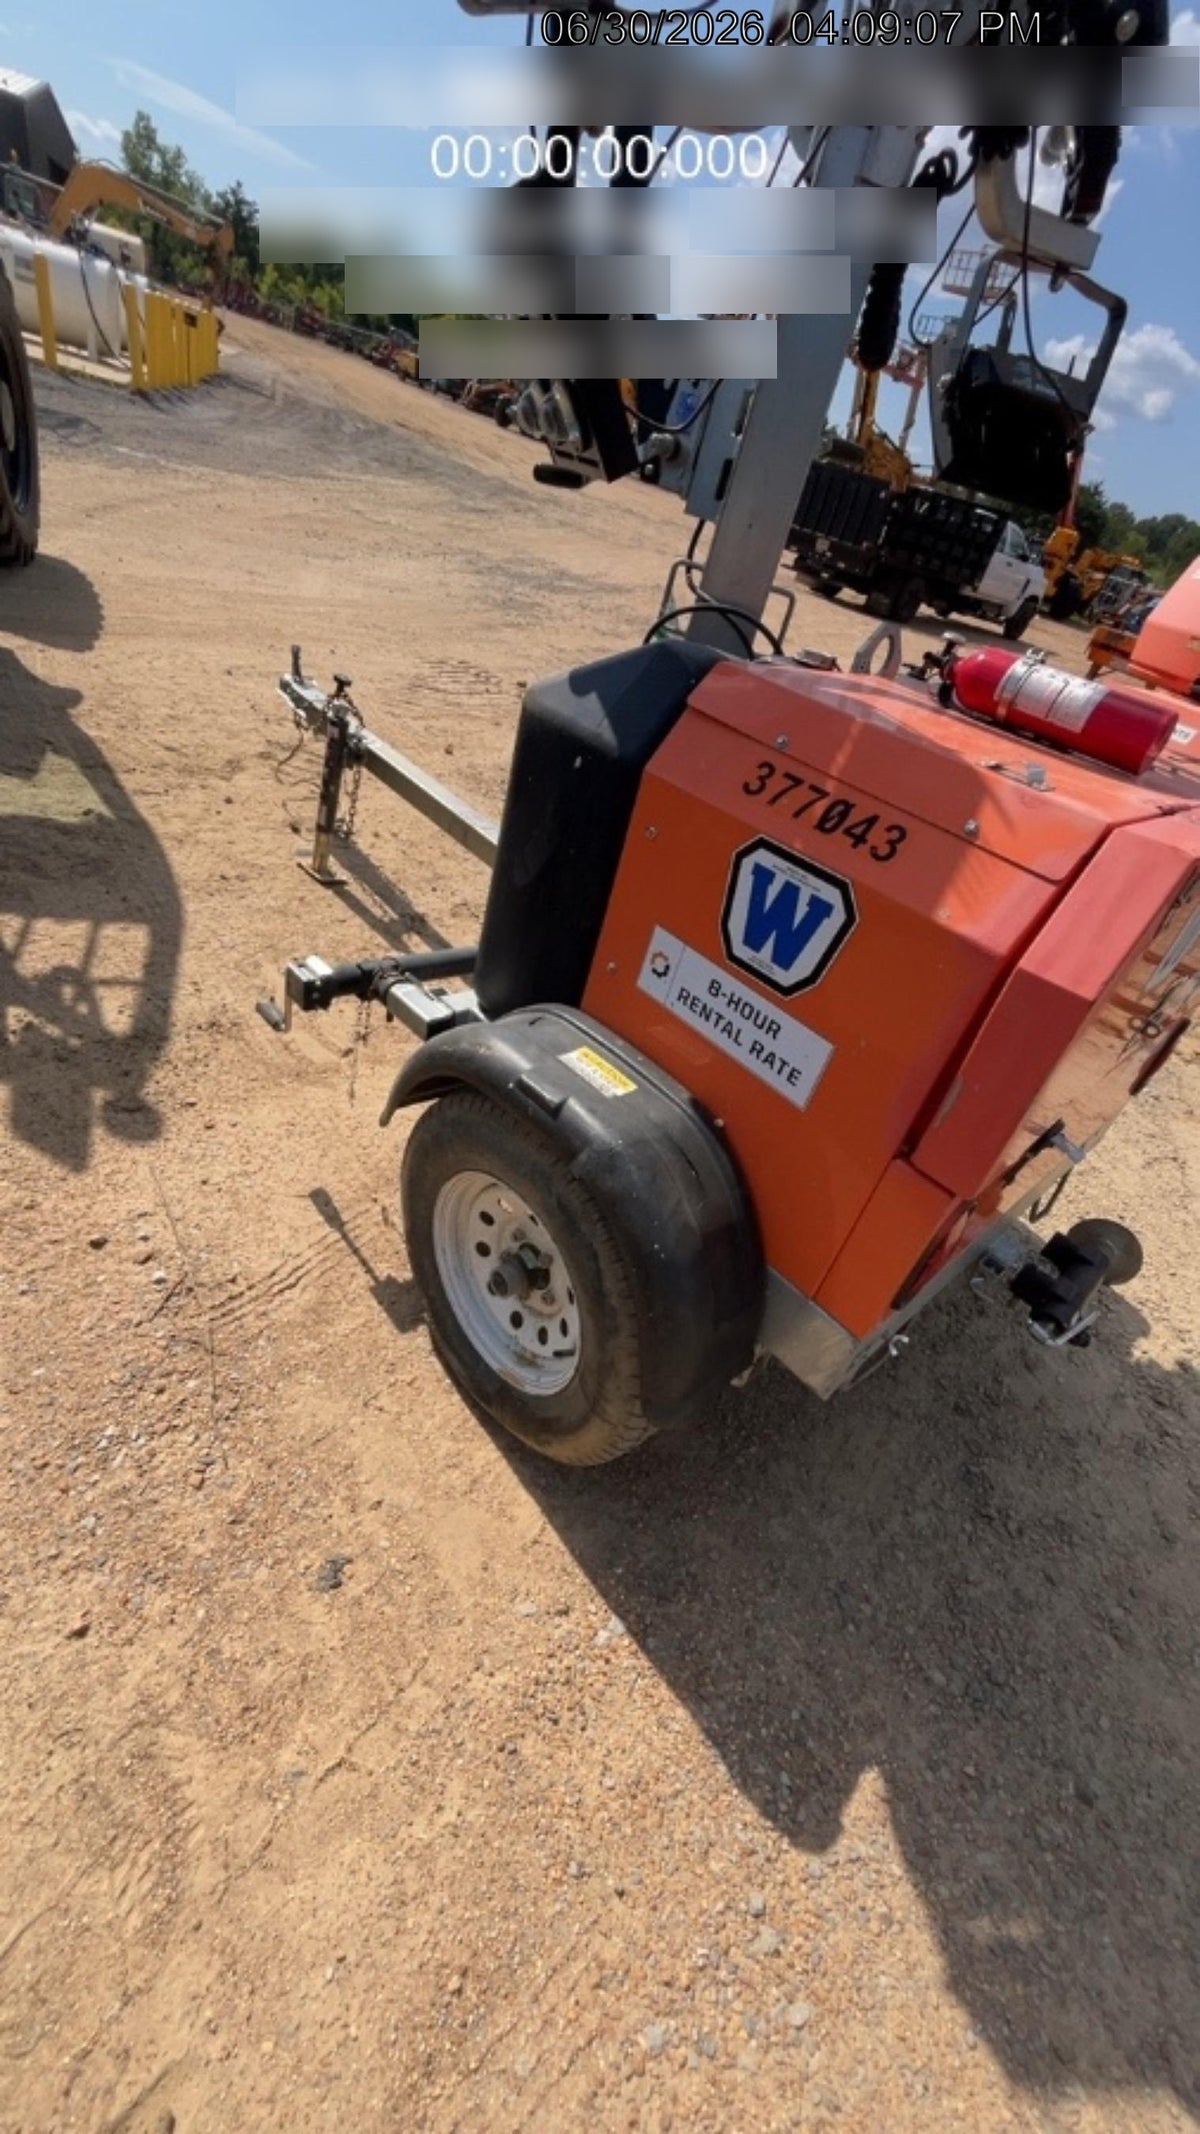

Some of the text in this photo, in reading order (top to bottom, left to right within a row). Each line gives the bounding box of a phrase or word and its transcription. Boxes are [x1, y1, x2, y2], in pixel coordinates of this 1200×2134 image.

[743, 762, 907, 862] 377043
[742, 862, 835, 972] W
[676, 986, 802, 1087] RENTAL RATE
[707, 978, 782, 1040] 8-HOUR
